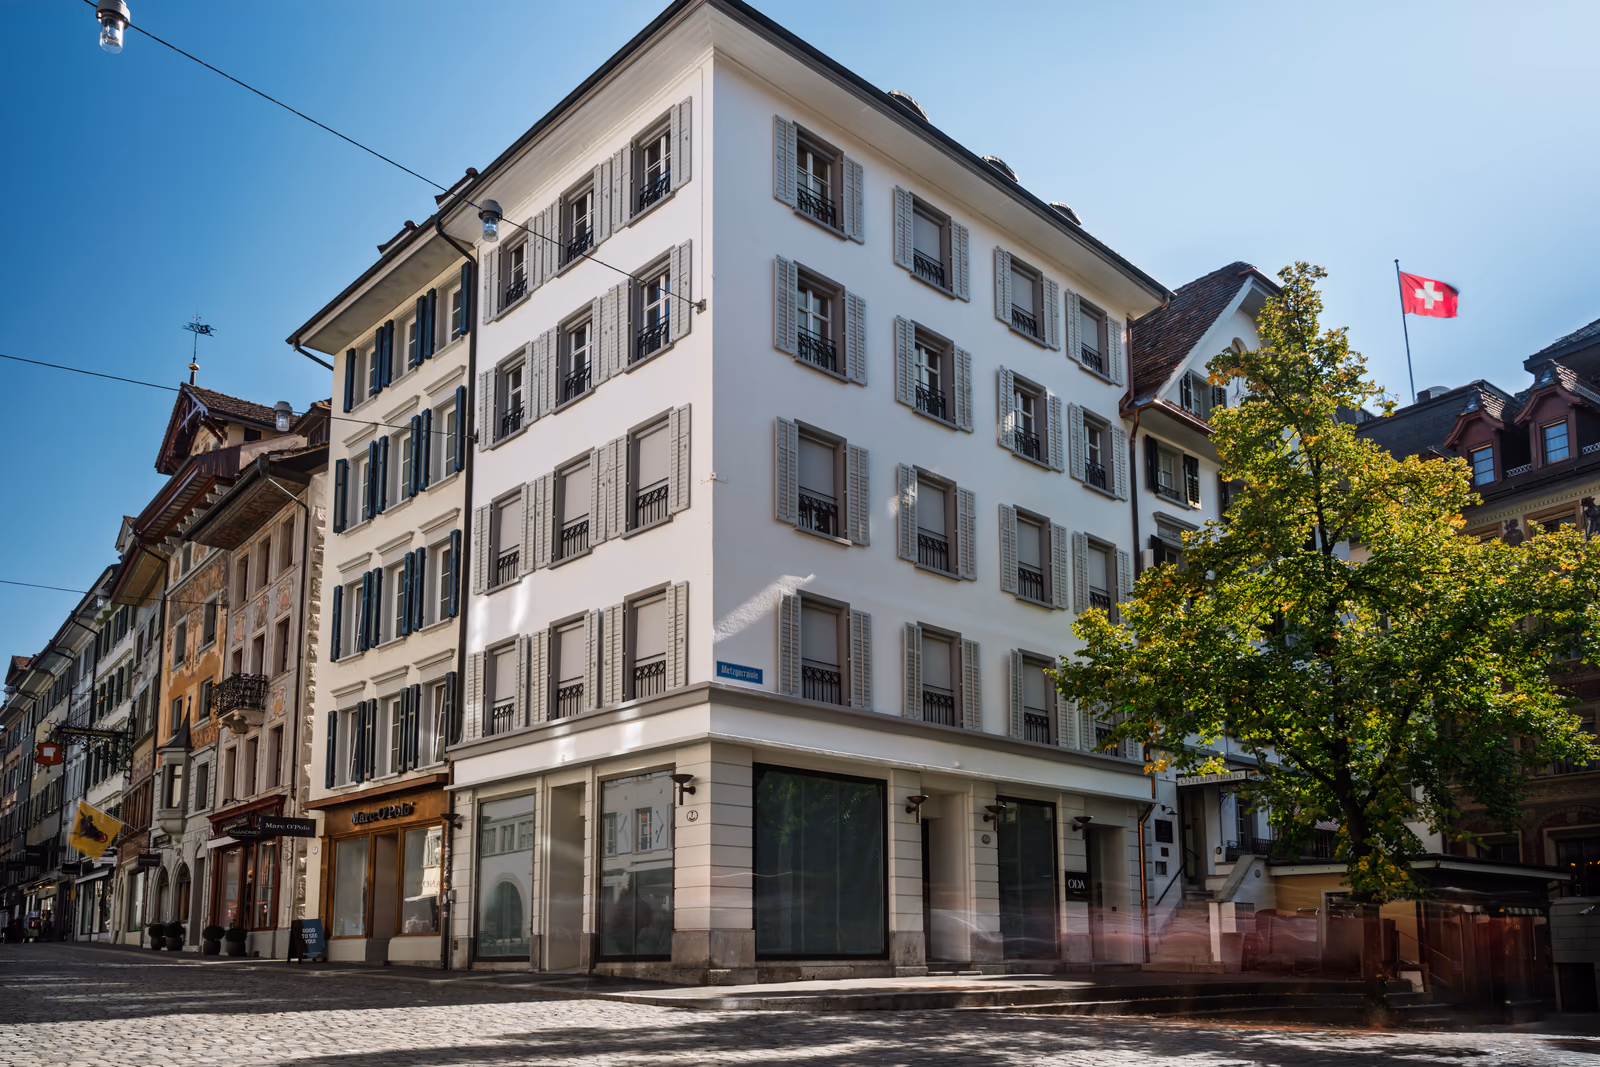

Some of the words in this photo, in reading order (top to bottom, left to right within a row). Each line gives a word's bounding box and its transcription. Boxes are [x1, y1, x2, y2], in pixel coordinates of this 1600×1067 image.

[350, 811, 375, 825] Marc
[265, 822, 286, 830] Marc
[287, 823, 311, 831] O'Polo
[1067, 878, 1086, 890] ODA
